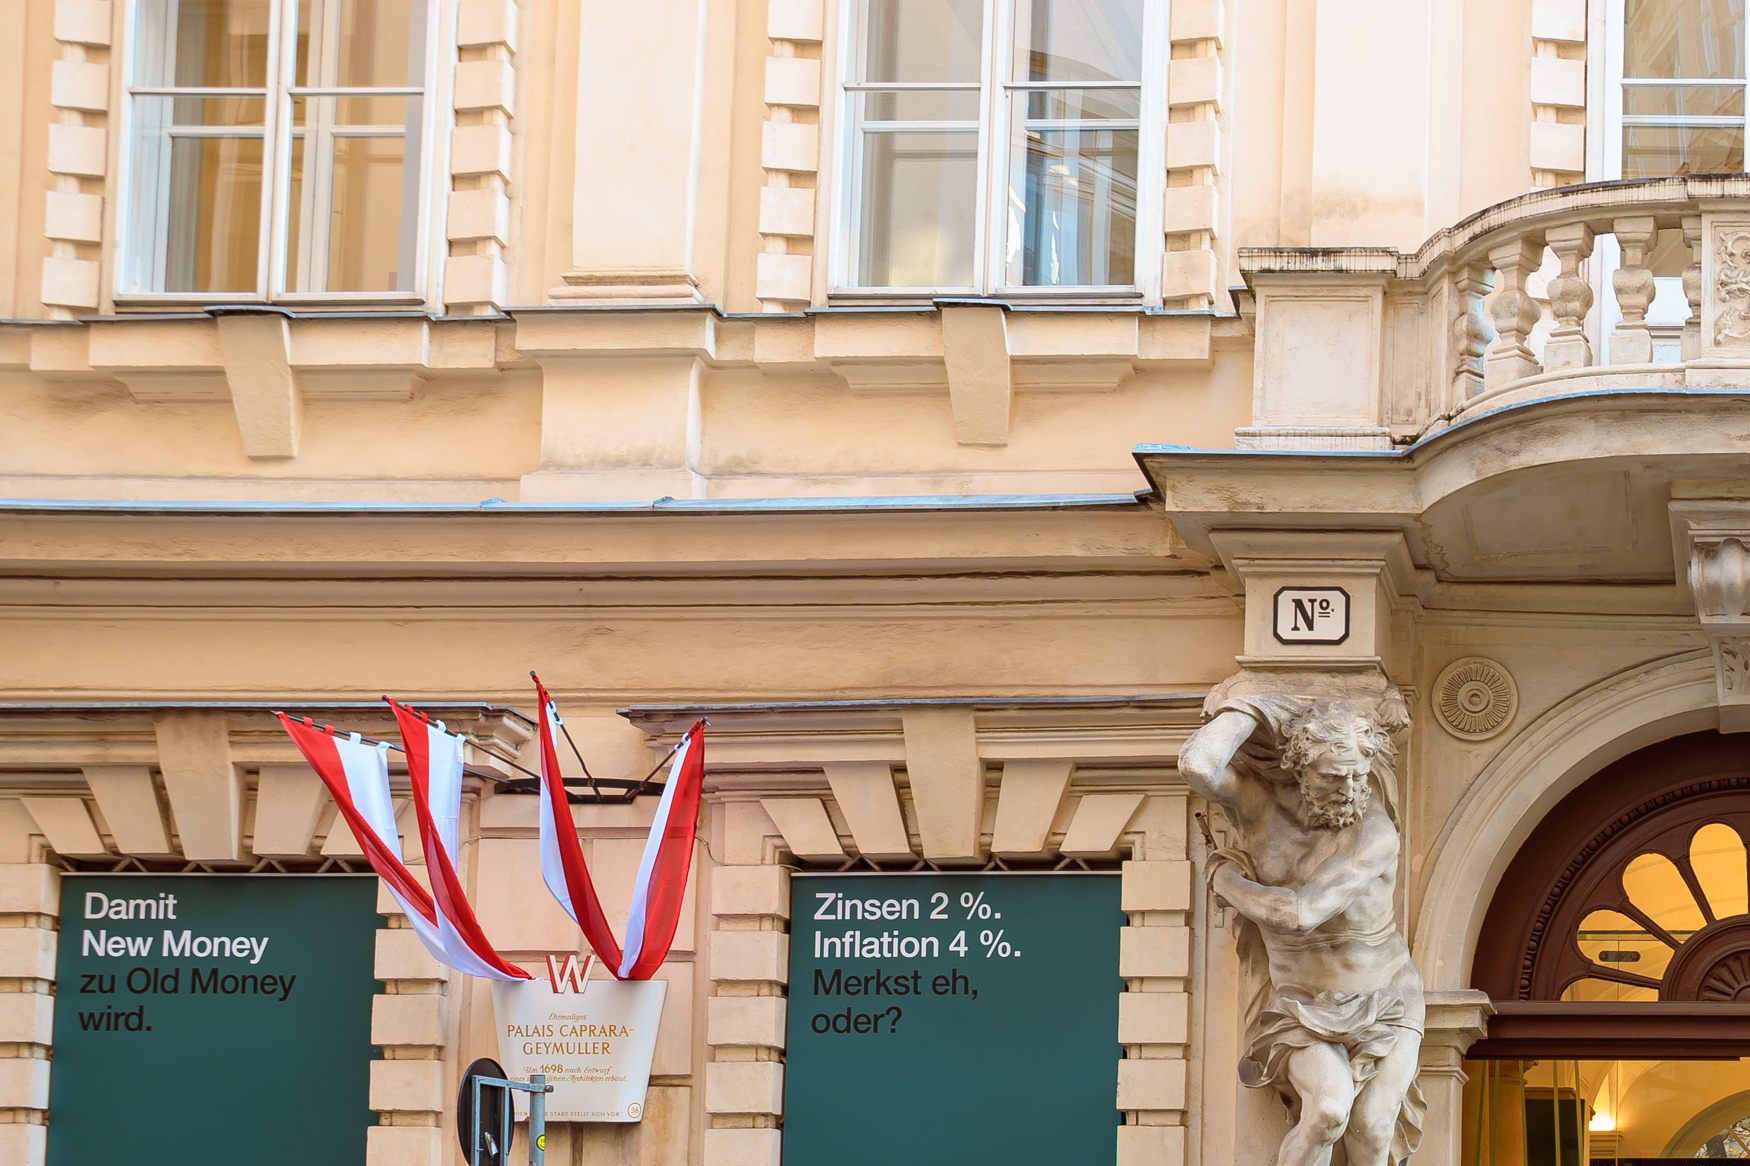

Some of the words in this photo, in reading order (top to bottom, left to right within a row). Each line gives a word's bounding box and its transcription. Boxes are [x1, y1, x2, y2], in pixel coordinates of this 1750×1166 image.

[84, 892, 178, 920] Damit
[813, 892, 920, 921] Zinsen
[929, 892, 949, 920] 2
[960, 891, 1002, 920] %.
[82, 929, 154, 958] New
[162, 929, 270, 965] Money
[814, 930, 939, 959] Inflation
[948, 930, 969, 958] 4
[979, 929, 1021, 958] %.
[79, 974, 116, 995] zu
[126, 966, 180, 995] Old
[190, 967, 297, 1002] Money
[545, 954, 597, 994] W
[813, 968, 923, 996] Merkst
[931, 968, 978, 1001] eh,
[77, 1004, 152, 1032] wird.
[507, 1024, 554, 1038] PALAIS
[559, 1024, 635, 1038] CAPRARA-
[548, 1012, 588, 1023] Ehemaliges
[811, 1005, 903, 1034] oder?
[522, 1066, 539, 1074] Um
[539, 1064, 564, 1075] 1698
[564, 1067, 582, 1075] nach
[583, 1066, 613, 1076] Entwurf
[630, 1106, 640, 1115] 36
